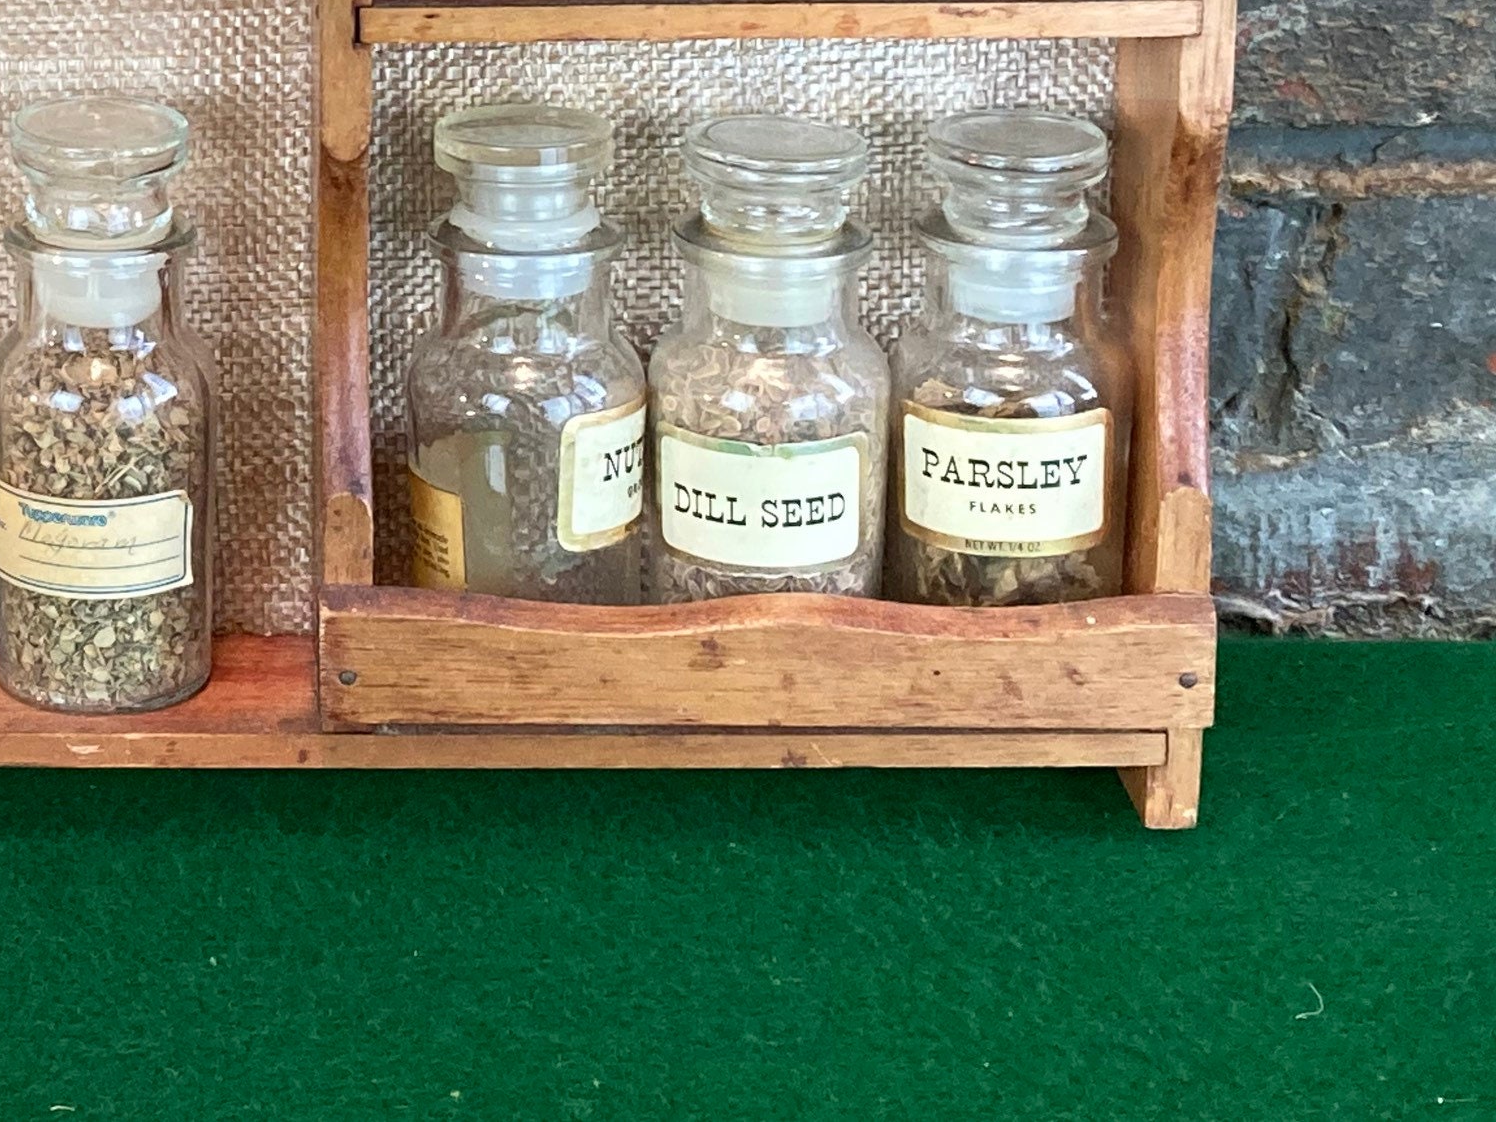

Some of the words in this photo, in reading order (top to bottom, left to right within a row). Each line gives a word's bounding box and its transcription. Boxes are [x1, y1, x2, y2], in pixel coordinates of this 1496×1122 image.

[922, 447, 1088, 490] PARSLEY
[674, 481, 747, 526] DILL
[761, 492, 846, 528] SEED
[969, 501, 1037, 515] FLAKES
[965, 538, 984, 550] NET
[1027, 542, 1041, 552] OZ
